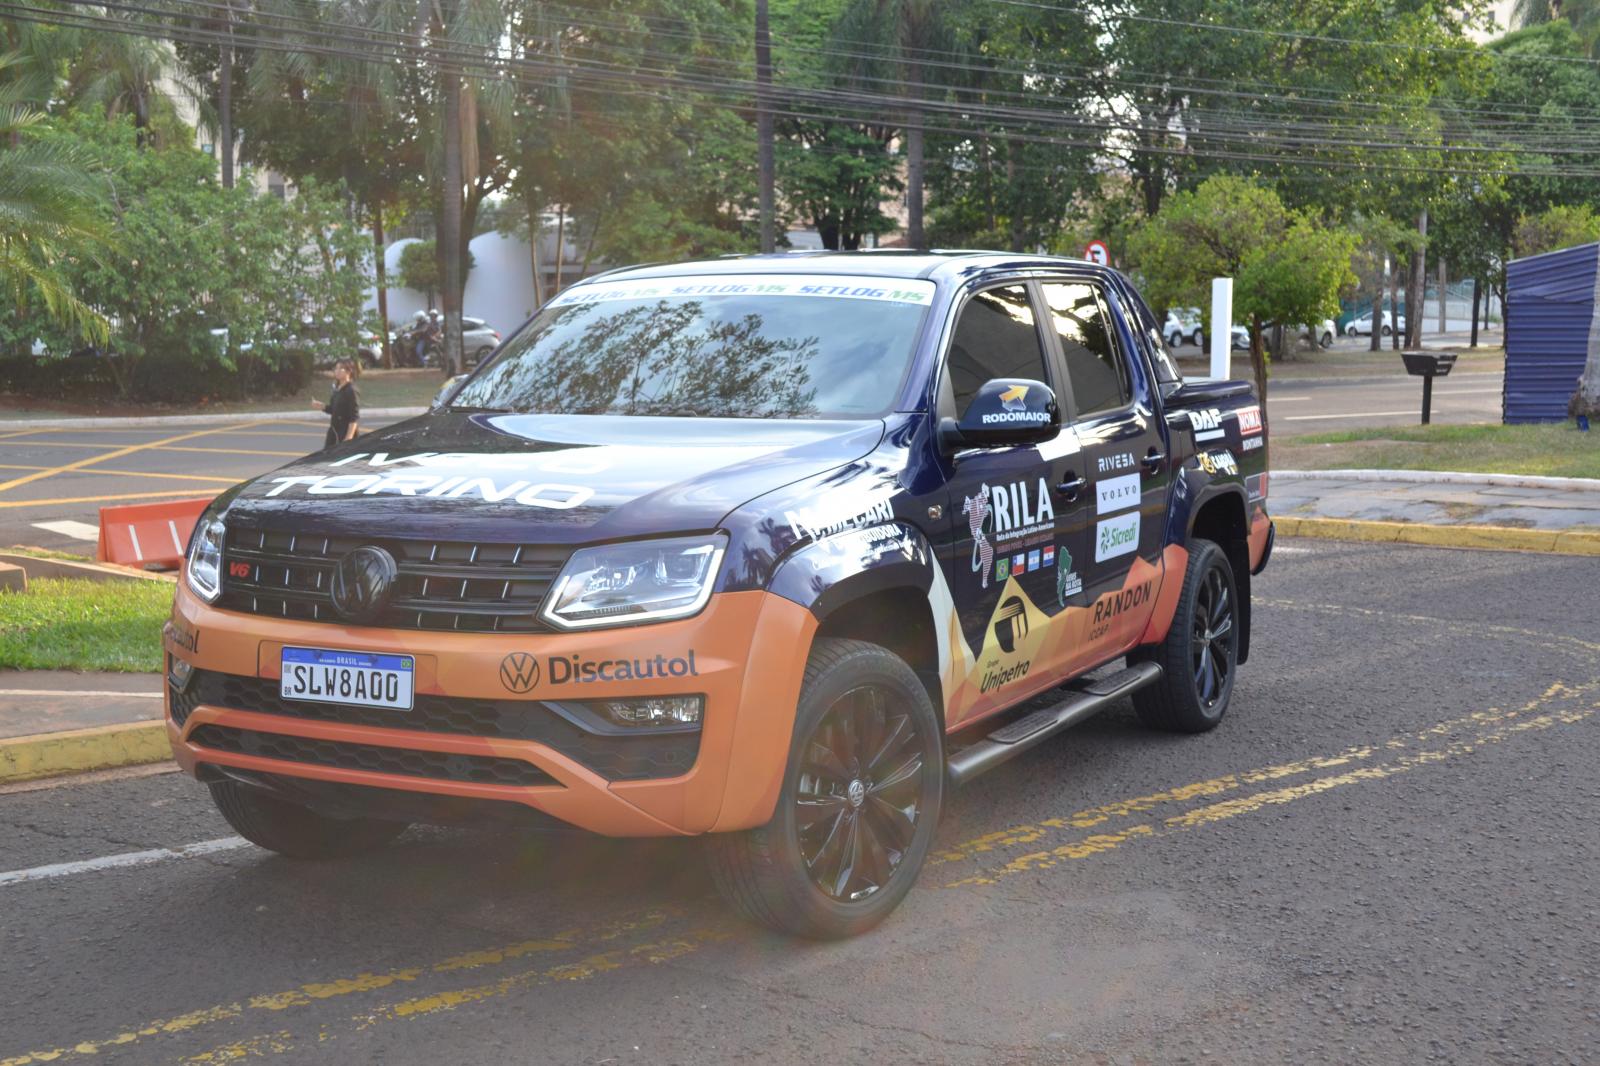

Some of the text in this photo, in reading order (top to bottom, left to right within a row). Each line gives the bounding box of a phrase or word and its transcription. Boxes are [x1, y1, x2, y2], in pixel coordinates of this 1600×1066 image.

[671, 285, 750, 295] SETLOG
[753, 285, 788, 294] MS
[799, 285, 888, 298] SETLOG
[889, 290, 928, 301] MS
[982, 411, 1051, 424] RODOMAIOR
[1188, 408, 1223, 431] DAF
[1097, 452, 1136, 473] RIVESA
[265, 474, 596, 510] TORINO
[1102, 486, 1138, 502] VOLVO
[992, 477, 1054, 532] RILA
[1111, 521, 1137, 548] Sicredi
[230, 560, 250, 577] V6
[1093, 580, 1152, 625] RANDON
[336, 656, 357, 666] BRASIL
[548, 648, 699, 684] Discautol
[294, 665, 398, 702] SLW8A00
[980, 660, 1030, 694] Unipetro
[284, 686, 292, 696] BR
